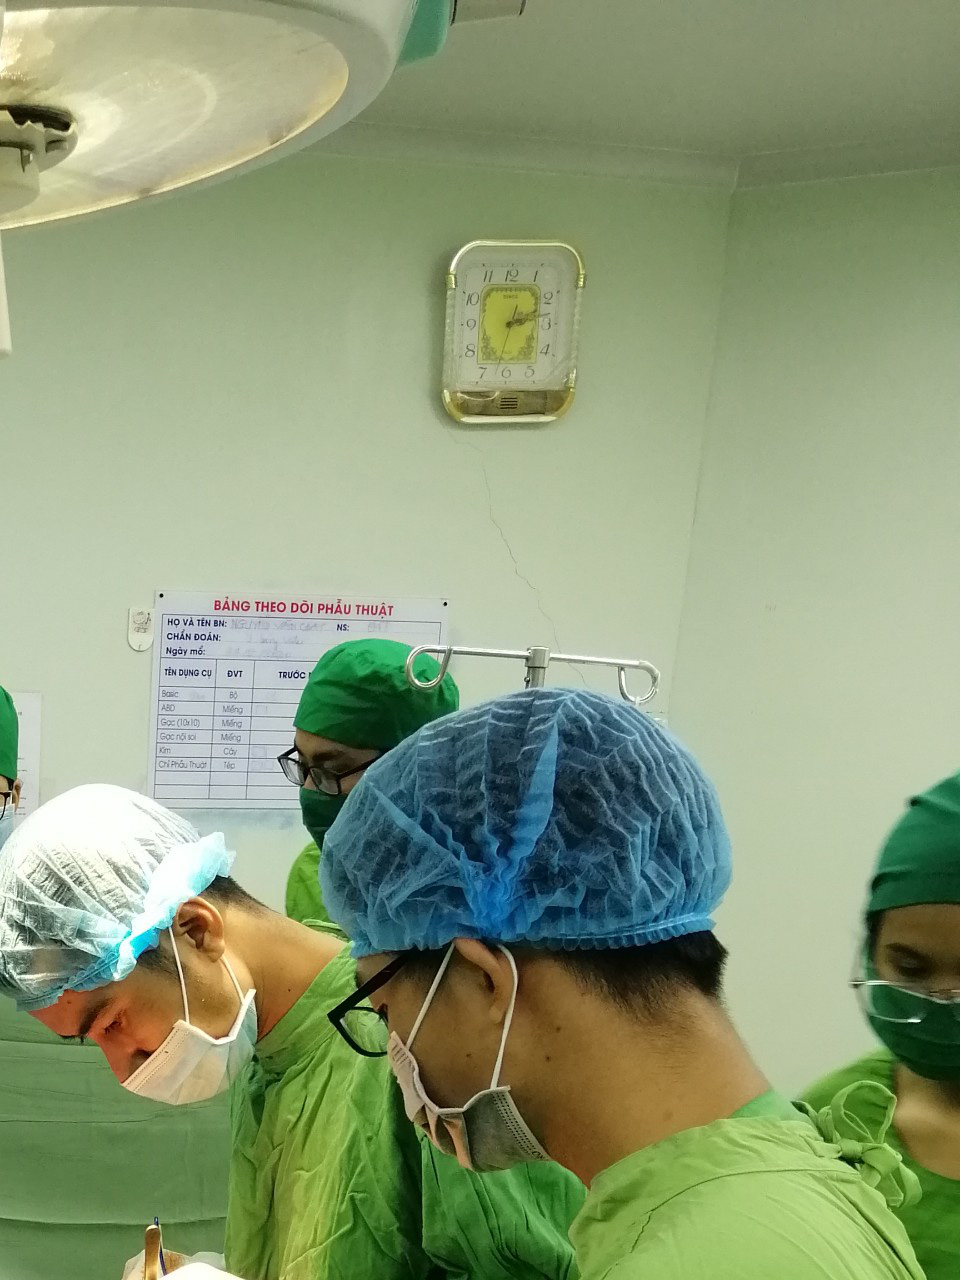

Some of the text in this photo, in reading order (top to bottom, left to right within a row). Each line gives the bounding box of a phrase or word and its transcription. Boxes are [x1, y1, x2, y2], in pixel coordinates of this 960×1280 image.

[484, 270, 493, 282] 11
[505, 269, 519, 282] 12
[466, 292, 479, 305] 10
[543, 292, 553, 304] 2
[467, 319, 476, 330] 9
[541, 318, 551, 330] 3
[465, 344, 475, 357] 8
[540, 344, 549, 355] 4
[479, 366, 487, 378] 7
[501, 367, 511, 378] 6
[525, 366, 534, 377] 5
[214, 596, 393, 619] BẢNG THEO DÕI PHẪU THUẬT
[167, 619, 180, 628] HỌ
[183, 616, 195, 627] VÀ
[197, 618, 211, 627] TÊN
[214, 619, 227, 628] BN:
[337, 623, 349, 632] NS:
[194, 631, 221, 642] ĐOÁN:
[166, 645, 205, 657] Ngày mổ:
[165, 667, 212, 679] TÊN DỤNG CỤ
[227, 670, 243, 678] ĐVT
[279, 669, 306, 679] TRƯỚC
[230, 691, 237, 699] Bộ
[223, 705, 243, 714] Miếng
[161, 719, 200, 727] Gạc (10x10)
[222, 719, 242, 728] Miếng
[160, 733, 175, 741] Gạc
[176, 733, 186, 741] nội
[221, 734, 241, 742] Miếng
